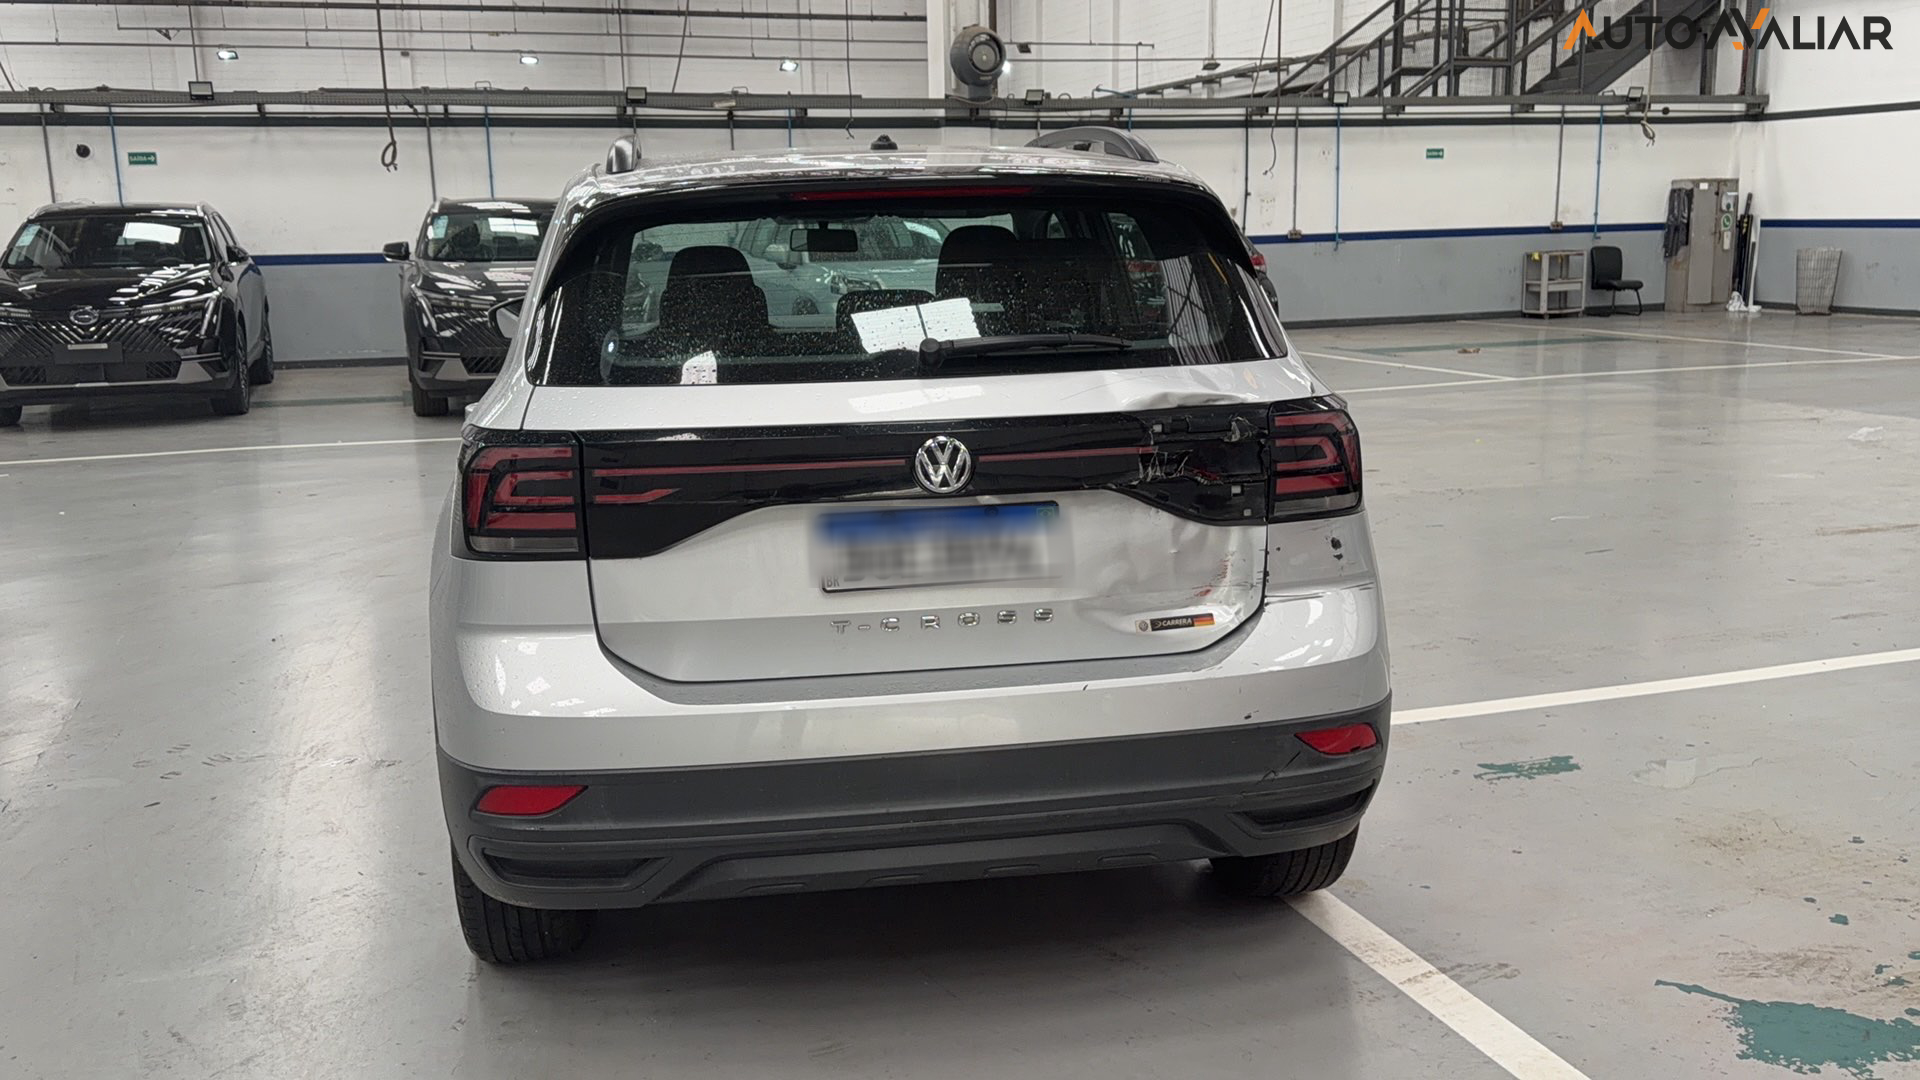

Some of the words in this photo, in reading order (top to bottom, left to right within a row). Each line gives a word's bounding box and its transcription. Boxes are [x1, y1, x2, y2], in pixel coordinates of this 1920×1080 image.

[826, 575, 840, 588] BR
[830, 608, 1053, 635] T-CROSS
[1162, 617, 1193, 626] CARRERA
